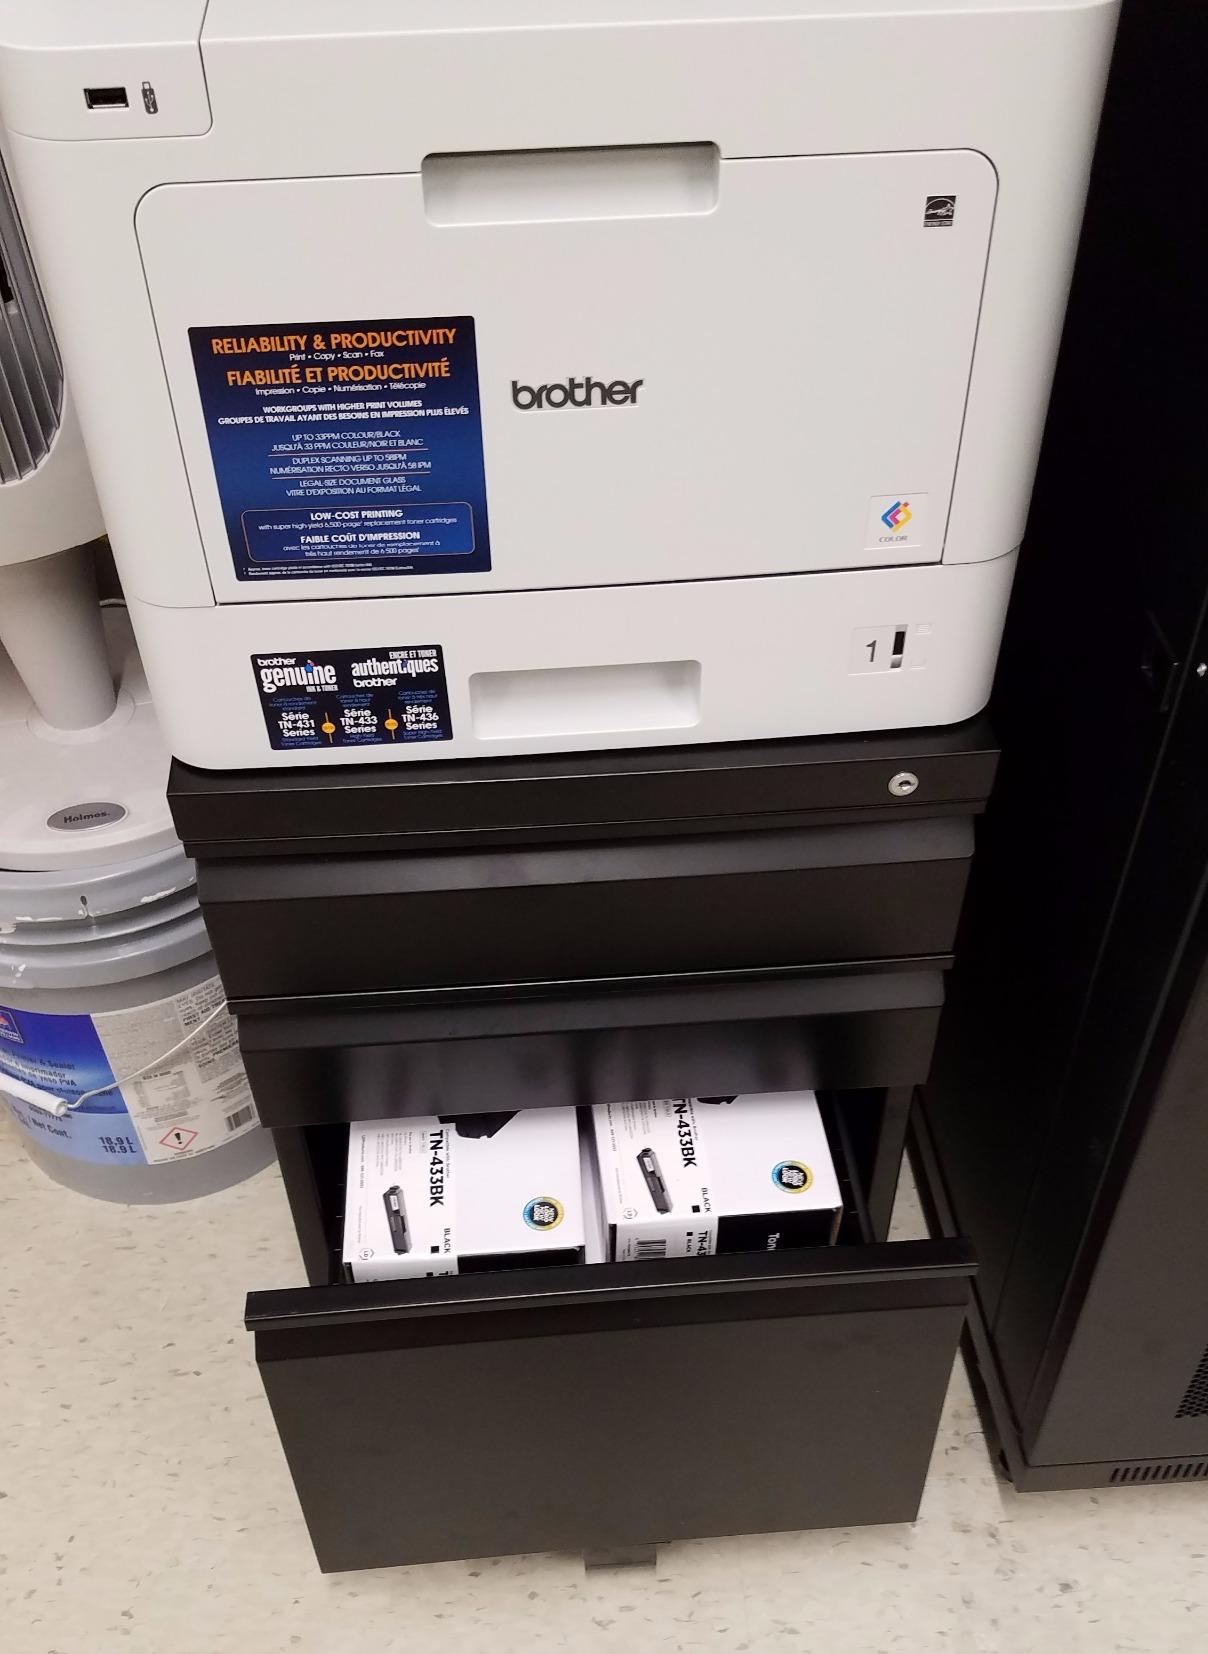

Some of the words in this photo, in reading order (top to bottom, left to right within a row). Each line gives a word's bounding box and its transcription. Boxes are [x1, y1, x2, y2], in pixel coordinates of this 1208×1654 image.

[212, 335, 307, 354] RELIABILITY
[313, 335, 326, 349] &
[330, 328, 456, 349] PRODUCTIVITY
[227, 364, 302, 385] FIABILITÉ
[305, 368, 322, 382] ET
[328, 357, 450, 381] PRODUCTIVITÉ
[256, 388, 294, 396] Impression
[302, 386, 326, 394] Copie
[334, 383, 382, 391] Numérisation
[389, 382, 426, 390] Télécopie
[512, 376, 643, 410] brother
[263, 405, 317, 413] WORKGROUPS
[387, 400, 422, 408] VOLUMES
[265, 415, 296, 423] TRAVAIL
[426, 408, 443, 416] PLUS
[341, 431, 400, 439] COLOUR/BLACK
[332, 440, 388, 448] COULEUR/NOIR
[270, 466, 324, 474] NUMÉRISATION
[399, 484, 422, 492] LÉGAL
[310, 511, 359, 520] LOW-COST
[361, 510, 403, 518] PRINTING
[301, 535, 329, 543] FAIBLE
[331, 533, 356, 542] COÛT
[359, 532, 420, 541] D'IMPRESSION
[866, 640, 877, 662] 1
[257, 658, 296, 666] brother
[351, 658, 438, 677] authentiques
[260, 665, 336, 693] genuine
[353, 678, 397, 688] brother
[344, 709, 371, 717] Série
[406, 705, 433, 713] Série
[282, 712, 309, 720] Série
[340, 716, 378, 726] TN-433
[402, 713, 439, 722] TN-436
[278, 720, 315, 729] TN-431
[345, 725, 376, 733] Series
[406, 722, 437, 730] Series
[283, 729, 315, 737] Series
[126, 1137, 133, 1145] L
[430, 1130, 444, 1207] TN-433BK
[701, 1188, 711, 1212] BLACK
[767, 1232, 780, 1250] Ton
